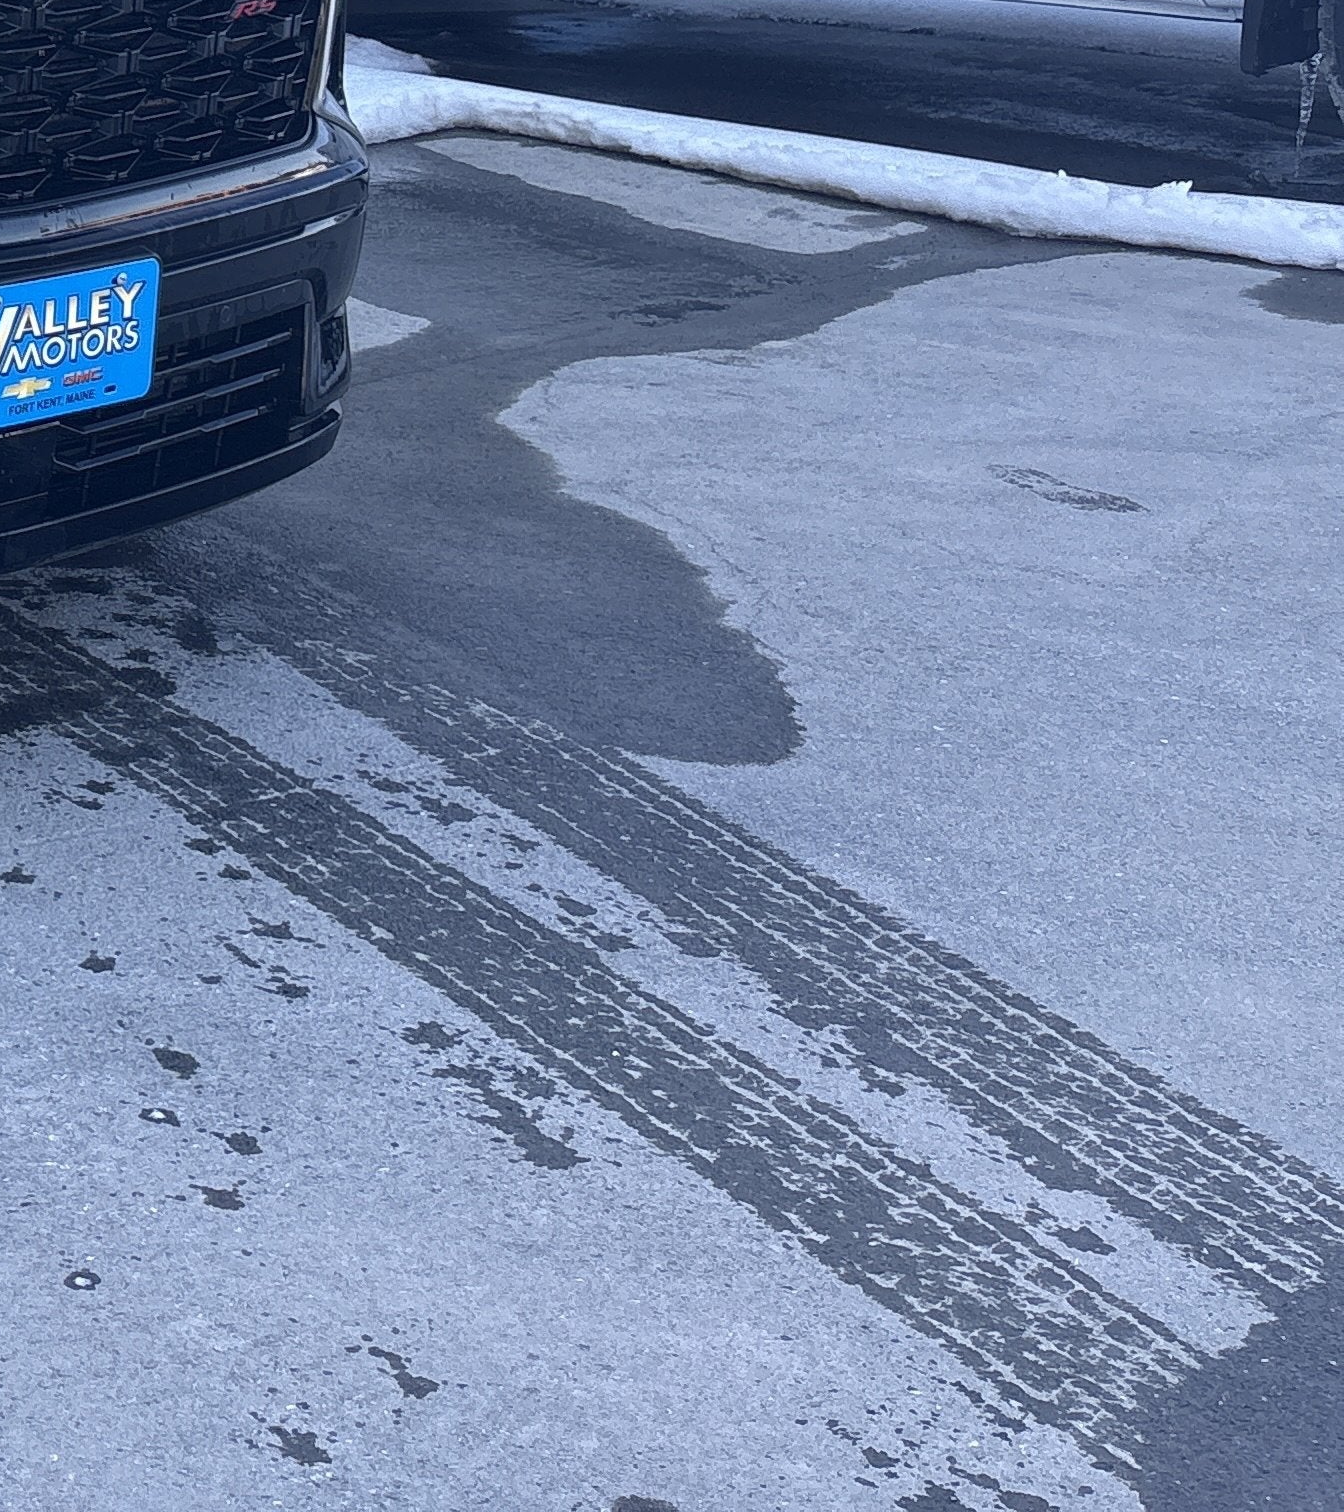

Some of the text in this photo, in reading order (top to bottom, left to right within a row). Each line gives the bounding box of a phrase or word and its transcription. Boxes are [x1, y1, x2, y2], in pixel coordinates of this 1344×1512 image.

[0, 319, 139, 377] MOTORS
[62, 367, 104, 387] GMC
[8, 402, 35, 417] FORT
[65, 389, 97, 404] MAINE
